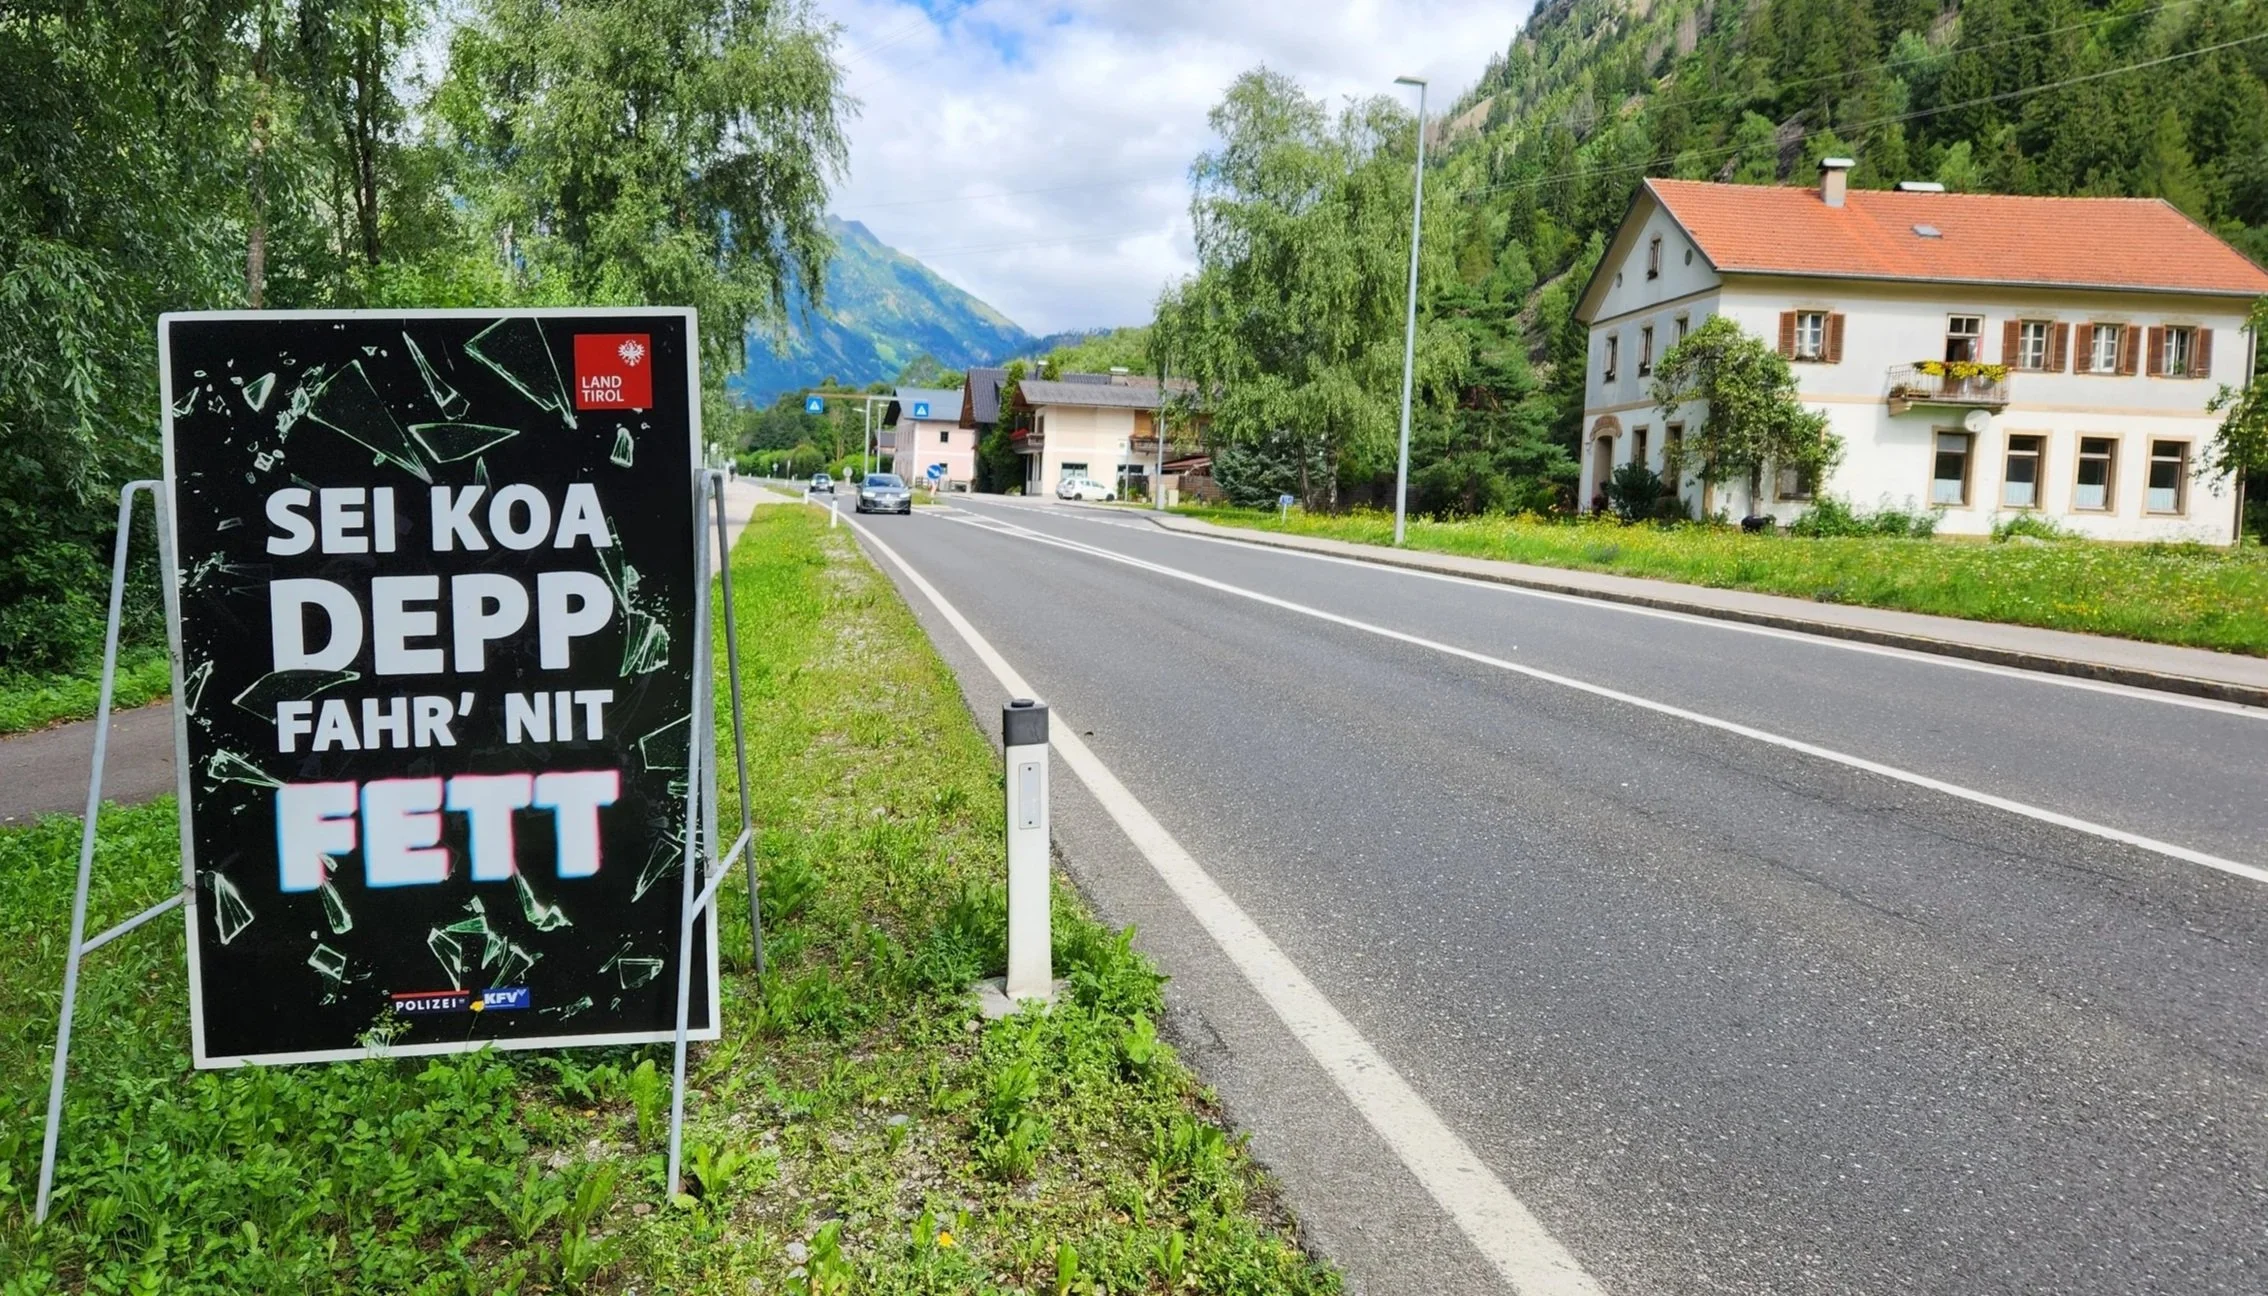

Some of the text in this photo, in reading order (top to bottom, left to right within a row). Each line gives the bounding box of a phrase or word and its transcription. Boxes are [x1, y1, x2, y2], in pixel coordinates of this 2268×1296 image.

[582, 375, 622, 388] LAND
[582, 389, 625, 403] TIROL
[266, 483, 613, 556] SEI KOA
[270, 571, 614, 676] DEPP
[277, 690, 613, 753] FAHR' NIT
[276, 770, 621, 893] FETT
[396, 998, 456, 1012] POLIZEI
[484, 992, 518, 1005] KFV
